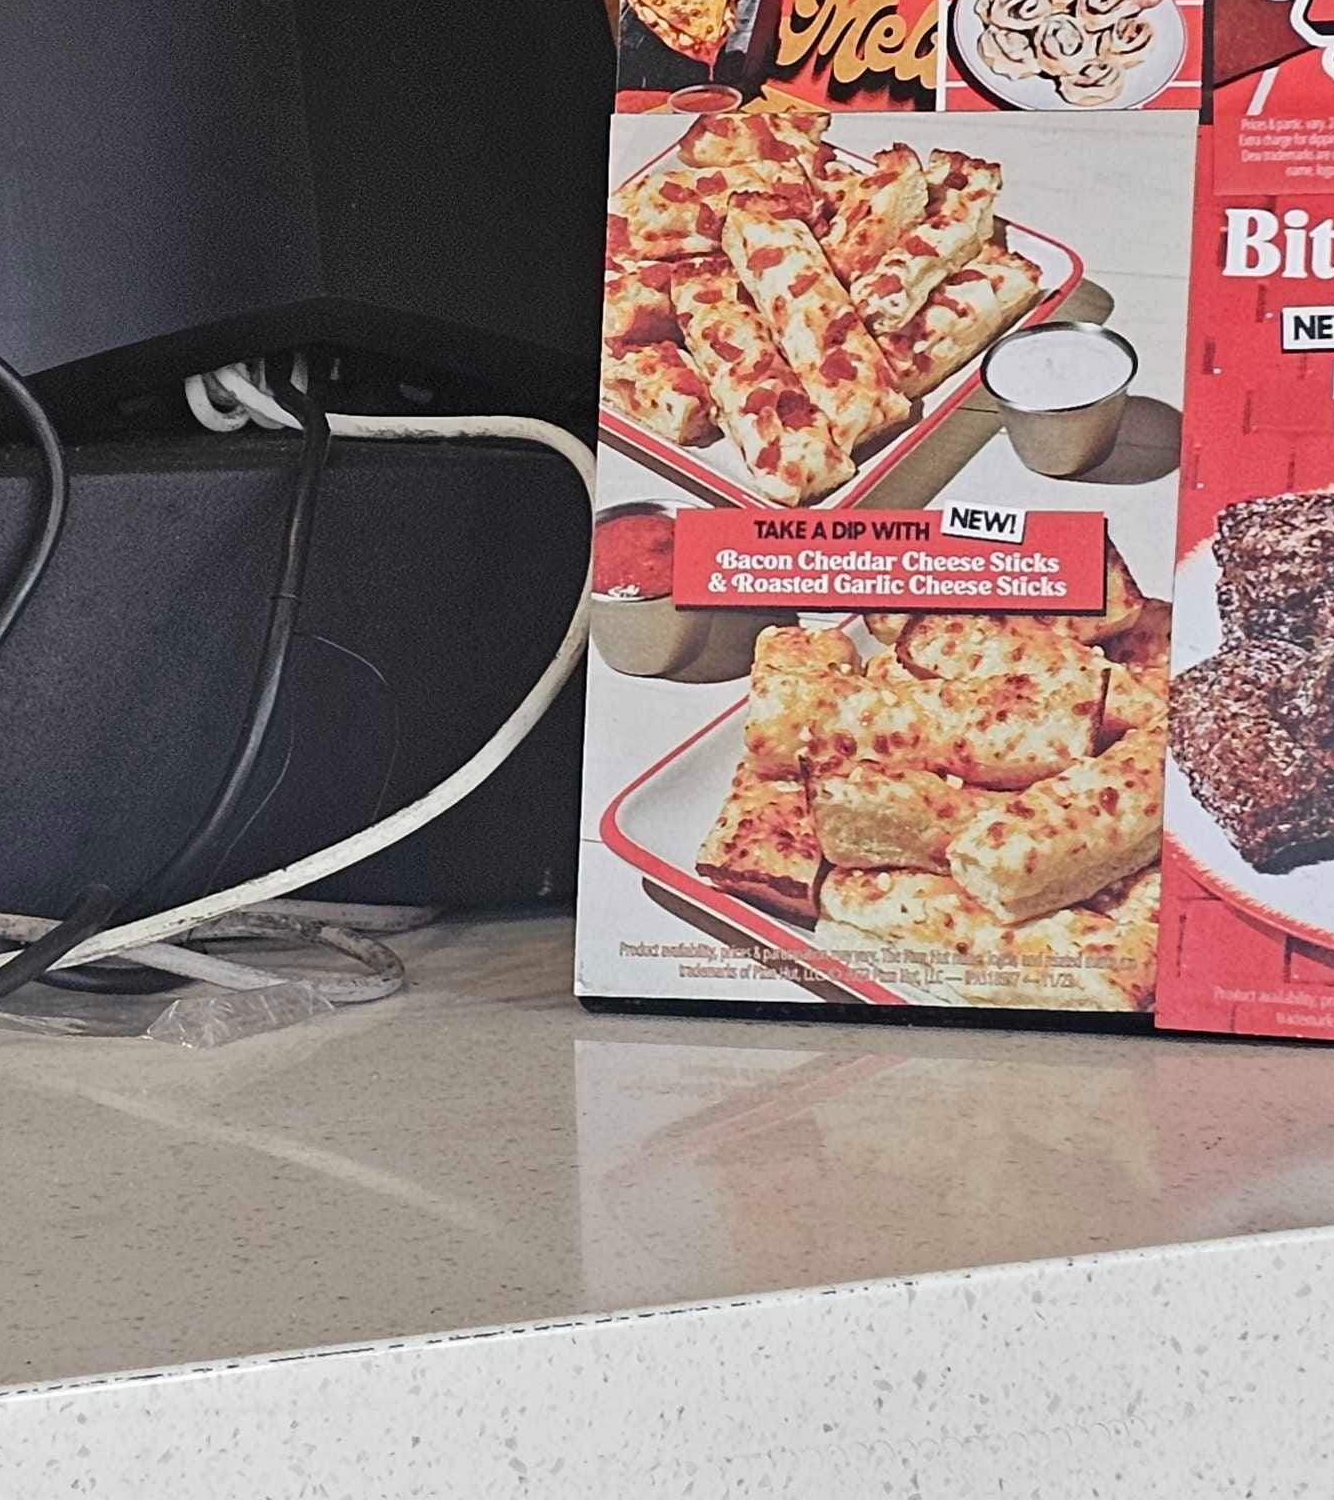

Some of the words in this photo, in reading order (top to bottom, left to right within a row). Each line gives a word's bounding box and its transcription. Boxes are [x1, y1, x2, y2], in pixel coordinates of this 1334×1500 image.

[753, 519, 806, 541] TAKE
[810, 519, 828, 541] A
[831, 519, 867, 541] DIP
[870, 520, 931, 542] WITH
[949, 506, 1017, 535] NEW!
[715, 549, 793, 573] Bacon
[797, 548, 898, 573] Cheddar
[901, 550, 986, 574] Cheese
[989, 551, 1061, 575] Sticks
[708, 574, 727, 595] &
[731, 573, 829, 596] Roasted
[833, 572, 906, 596] Garlic
[908, 574, 993, 598] Cheese
[996, 575, 1068, 599] Sticks
[619, 942, 659, 956] Product
[679, 964, 737, 978] trademarks
